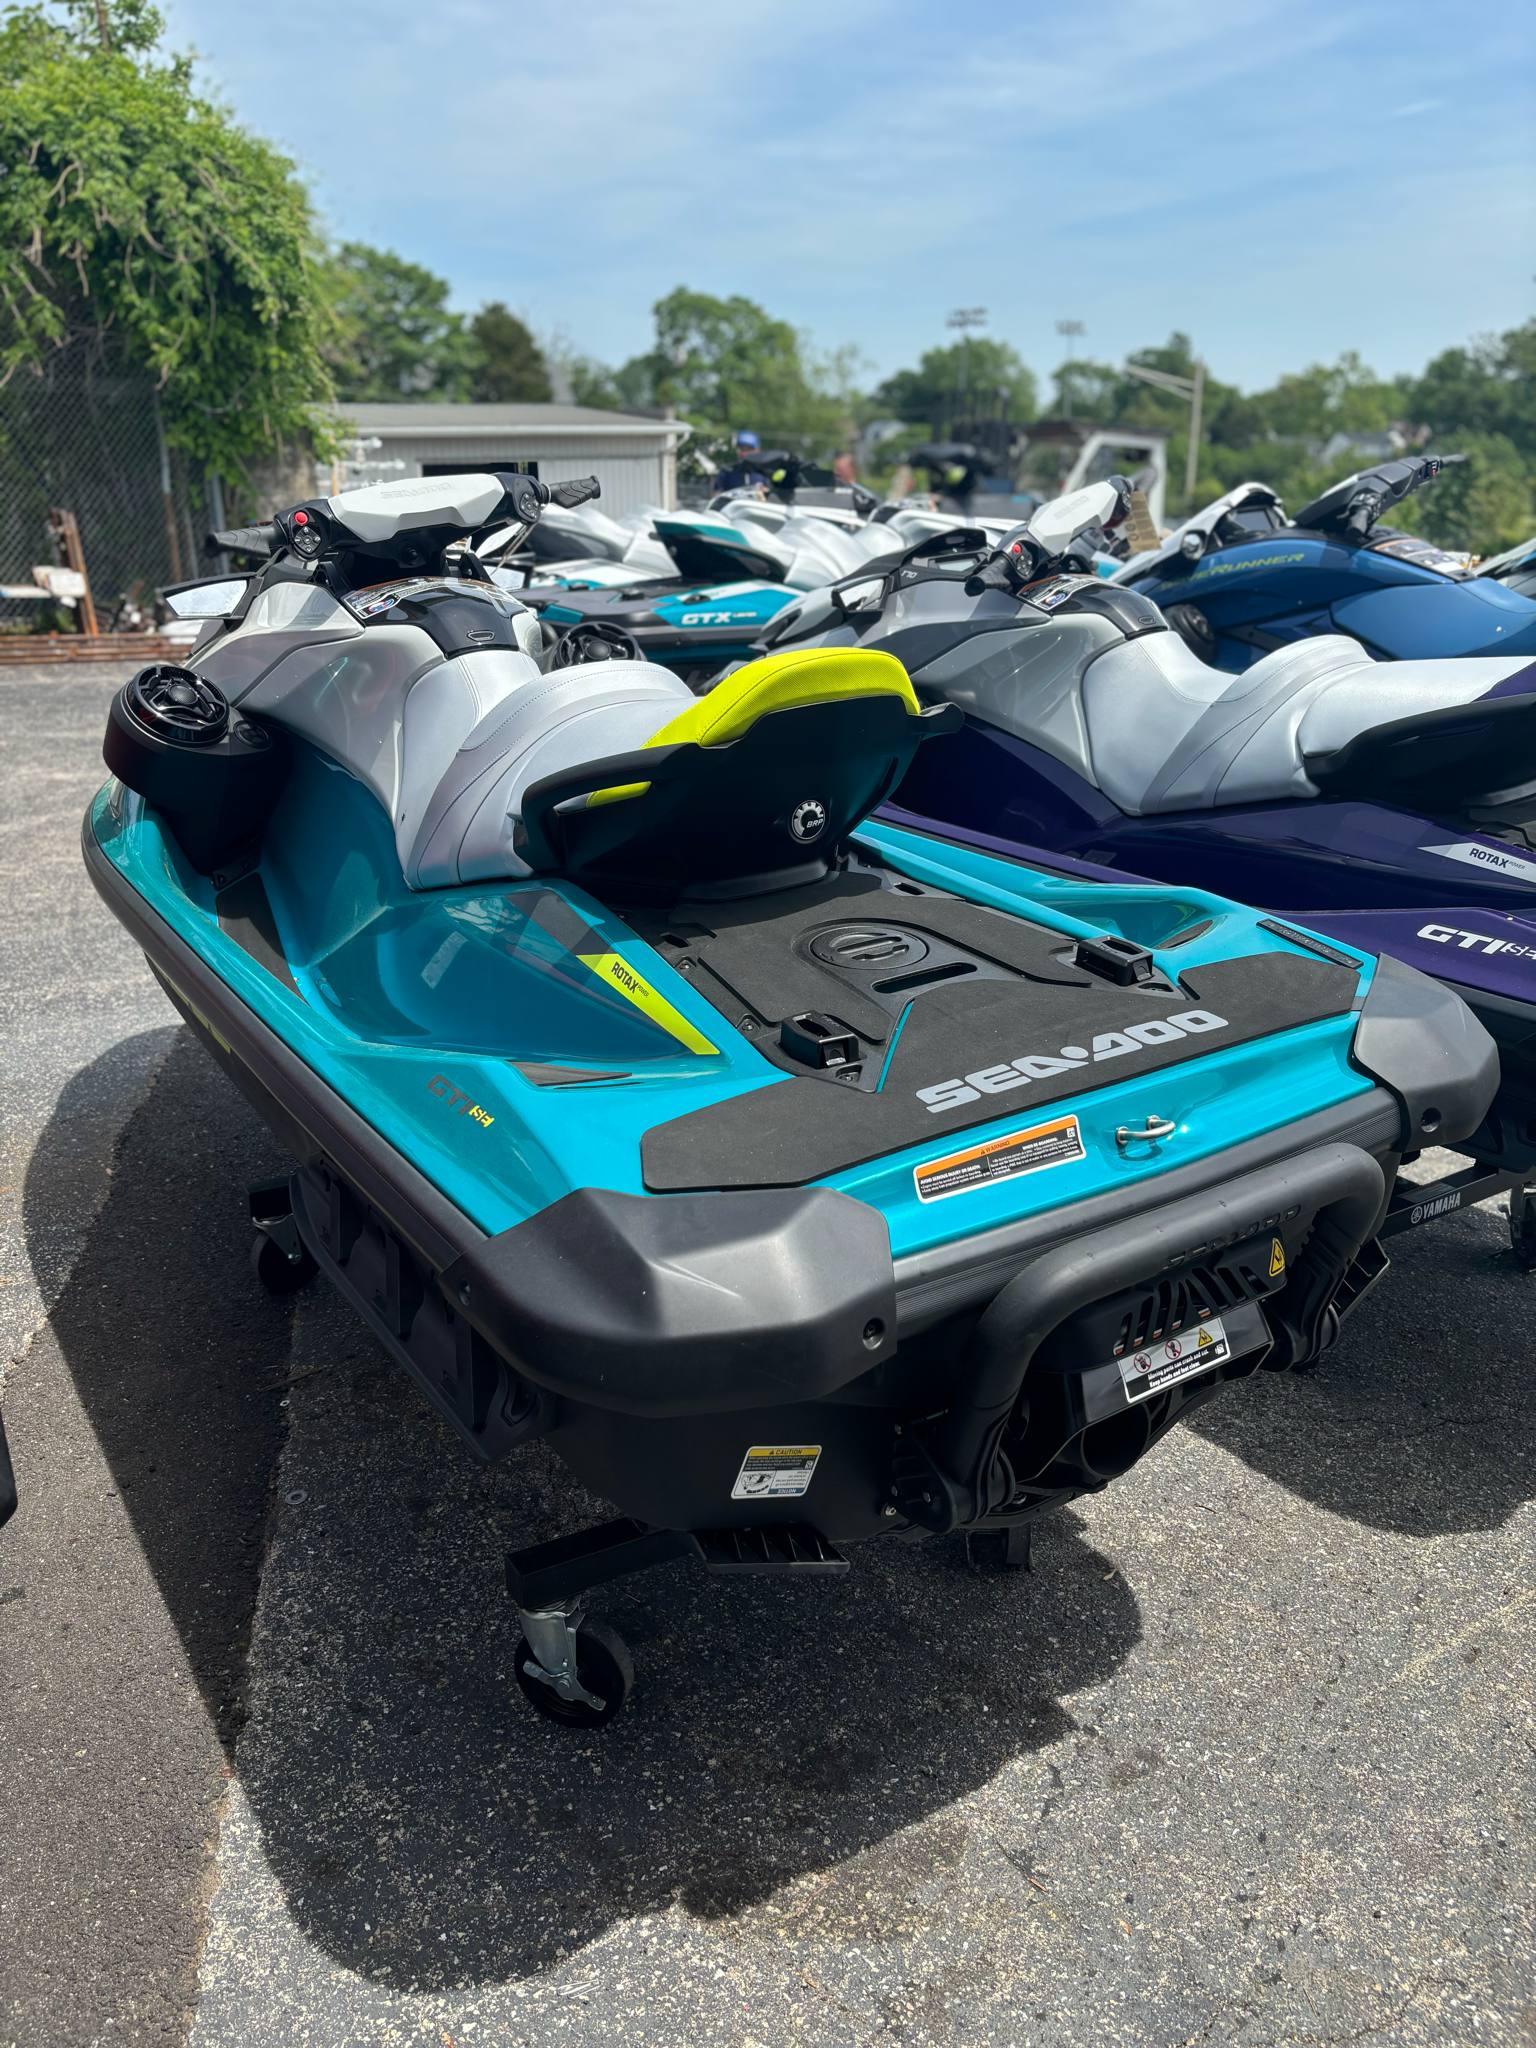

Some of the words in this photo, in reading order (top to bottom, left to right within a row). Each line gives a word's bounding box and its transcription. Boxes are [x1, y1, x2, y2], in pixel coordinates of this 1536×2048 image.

[681, 611, 731, 625] GTX
[806, 818, 824, 828] BRP
[1469, 847, 1509, 869] ROTAX
[1416, 924, 1507, 955] GTI
[611, 961, 639, 994] ROTAX
[1423, 1192, 1461, 1219] YAMAHA
